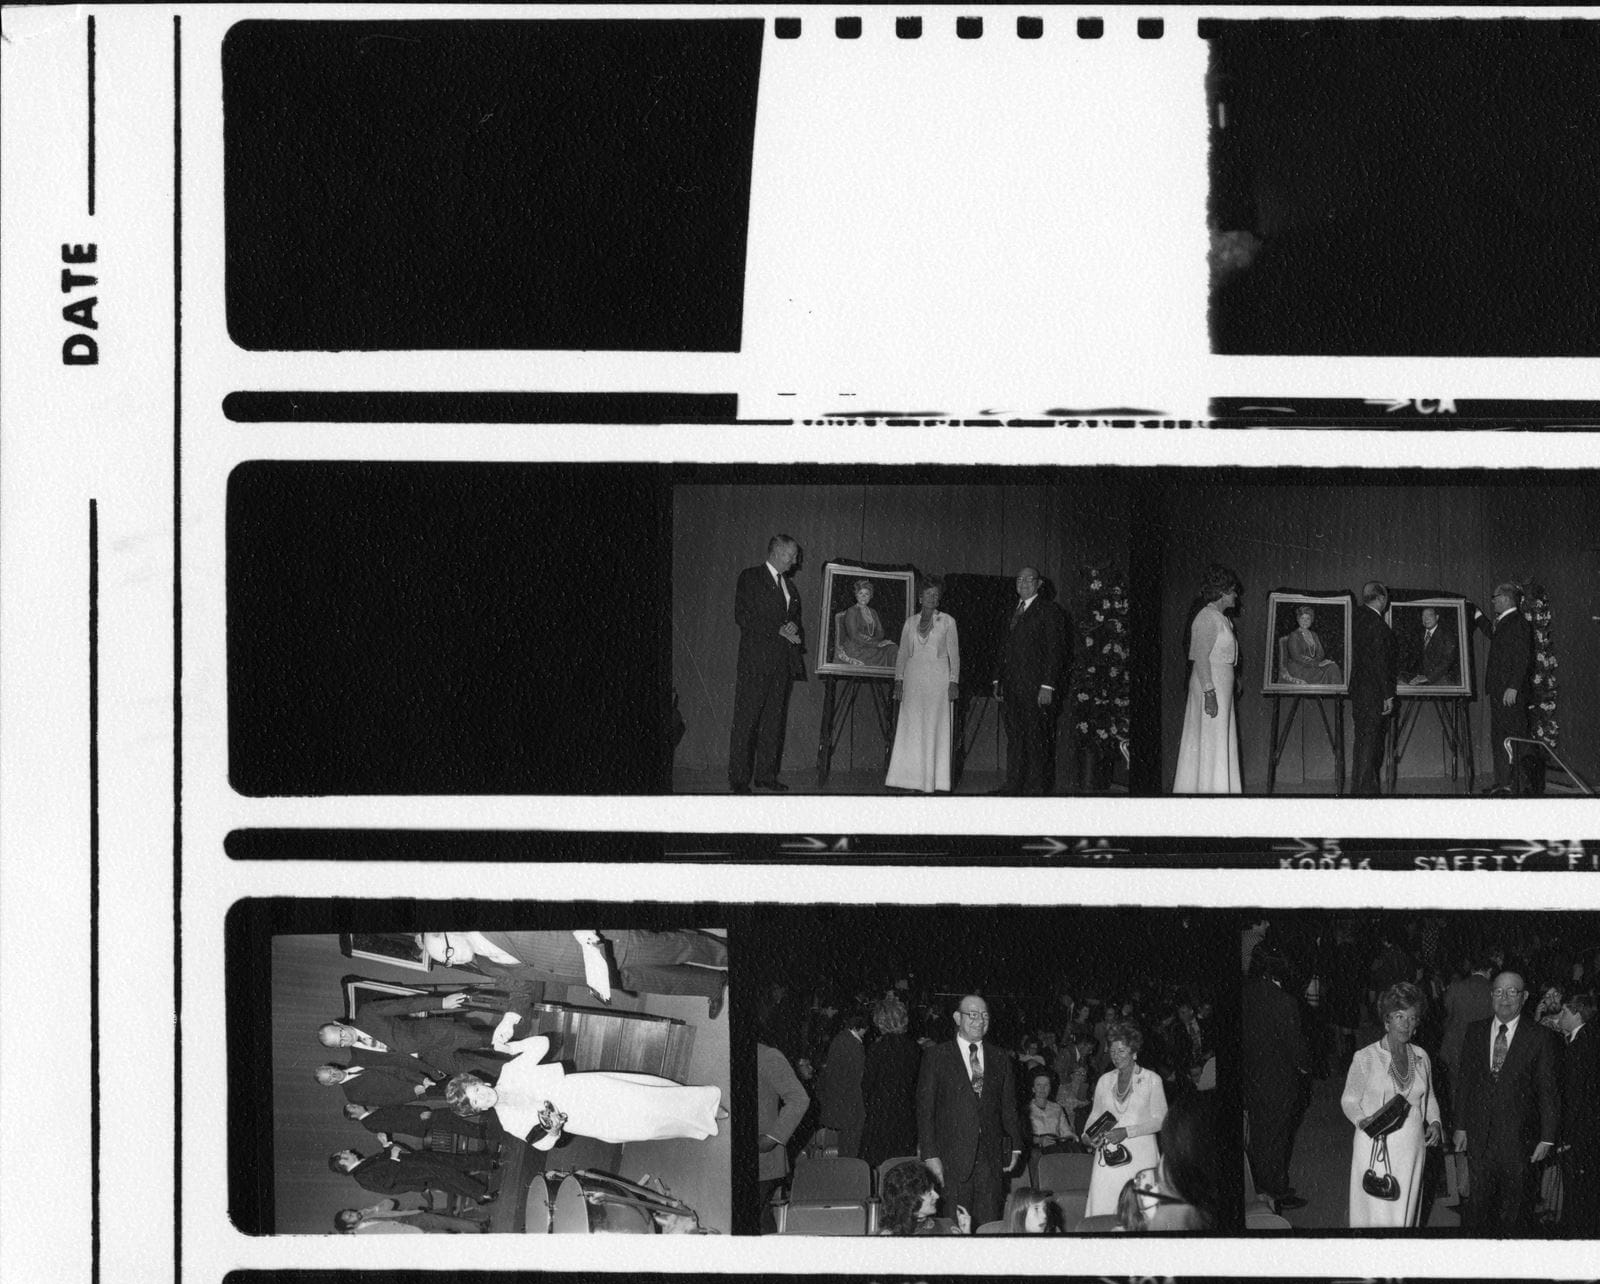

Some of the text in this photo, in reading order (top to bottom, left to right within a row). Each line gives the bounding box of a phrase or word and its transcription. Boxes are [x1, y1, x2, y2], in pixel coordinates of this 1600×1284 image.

[60, 243, 99, 365] DATE
[1322, 839, 1342, 858] 5
[1279, 857, 1371, 871] KODAK
